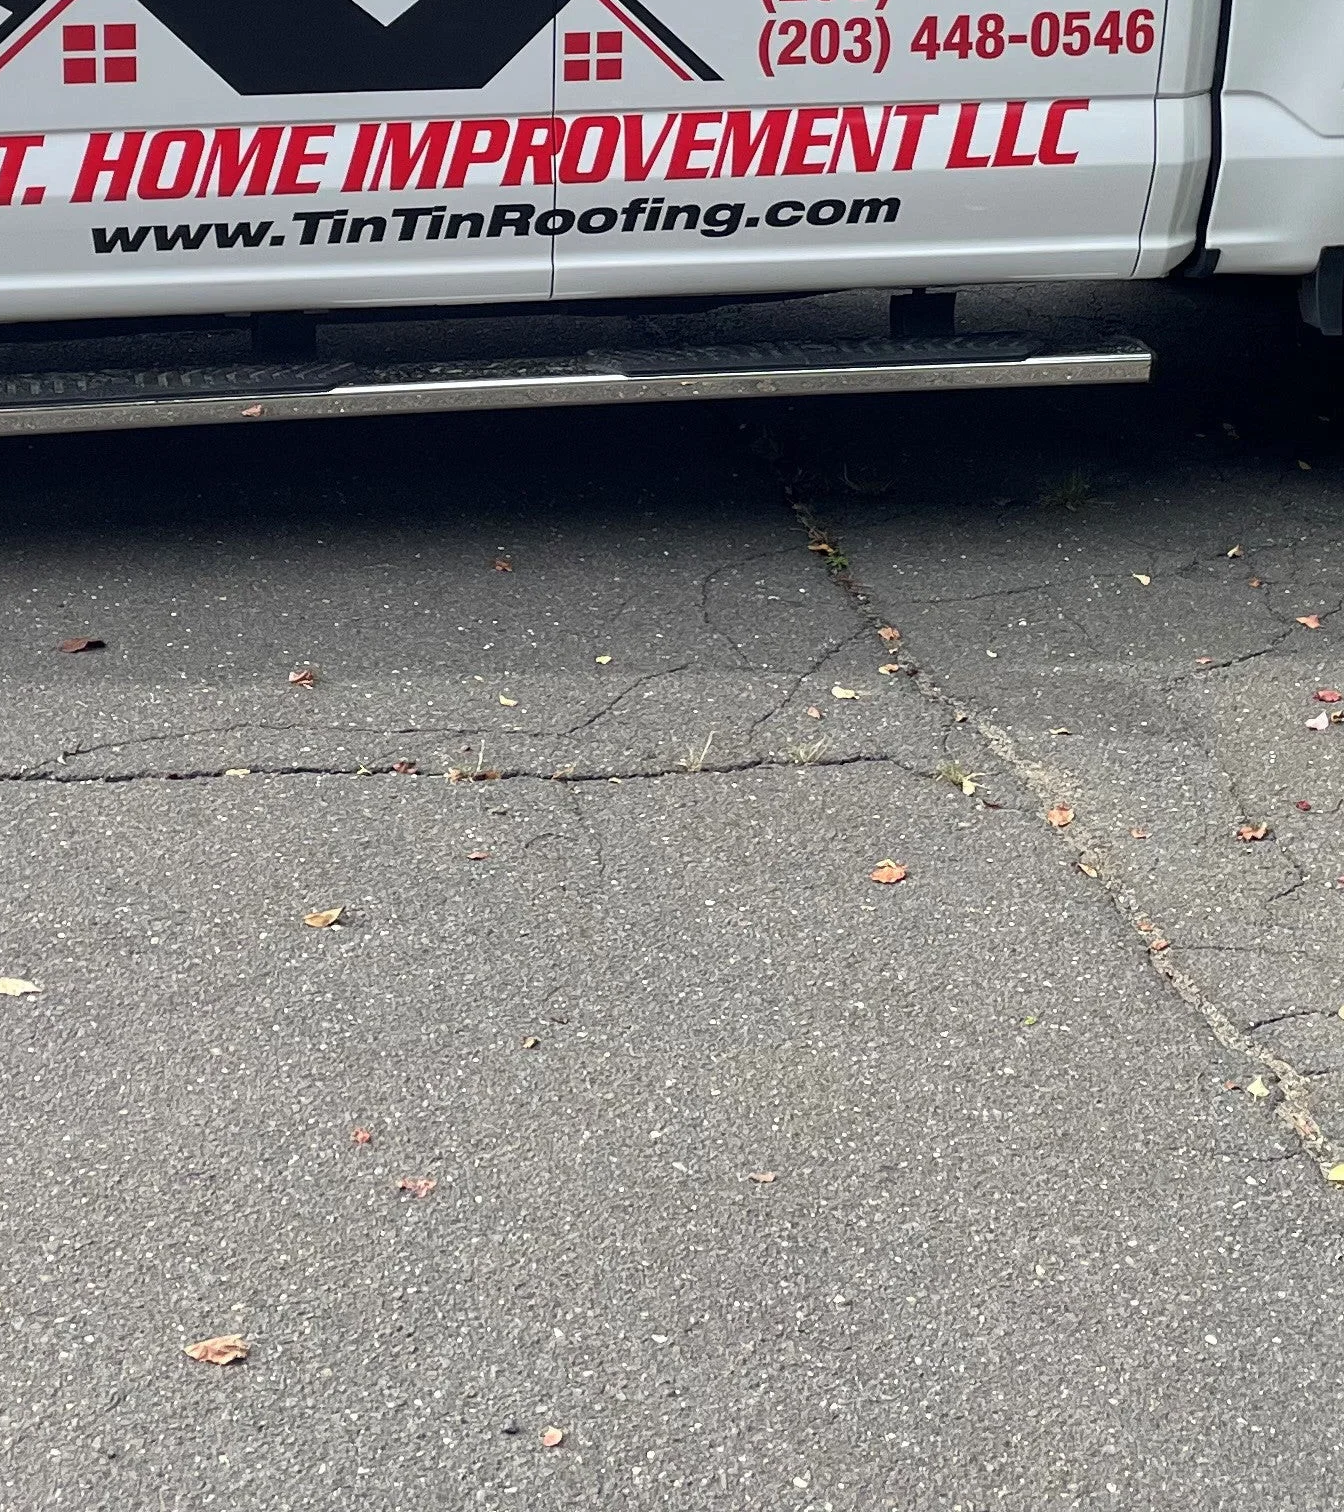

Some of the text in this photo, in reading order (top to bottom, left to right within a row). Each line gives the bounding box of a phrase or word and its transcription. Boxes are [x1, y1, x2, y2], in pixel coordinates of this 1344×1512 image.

[758, 8, 1155, 77] (203) 448-0546
[70, 124, 336, 203] HOME
[340, 103, 940, 193] IMPROVEMENT
[945, 98, 1090, 169] LLC
[91, 196, 901, 255] www.TinTinRoofing.com
